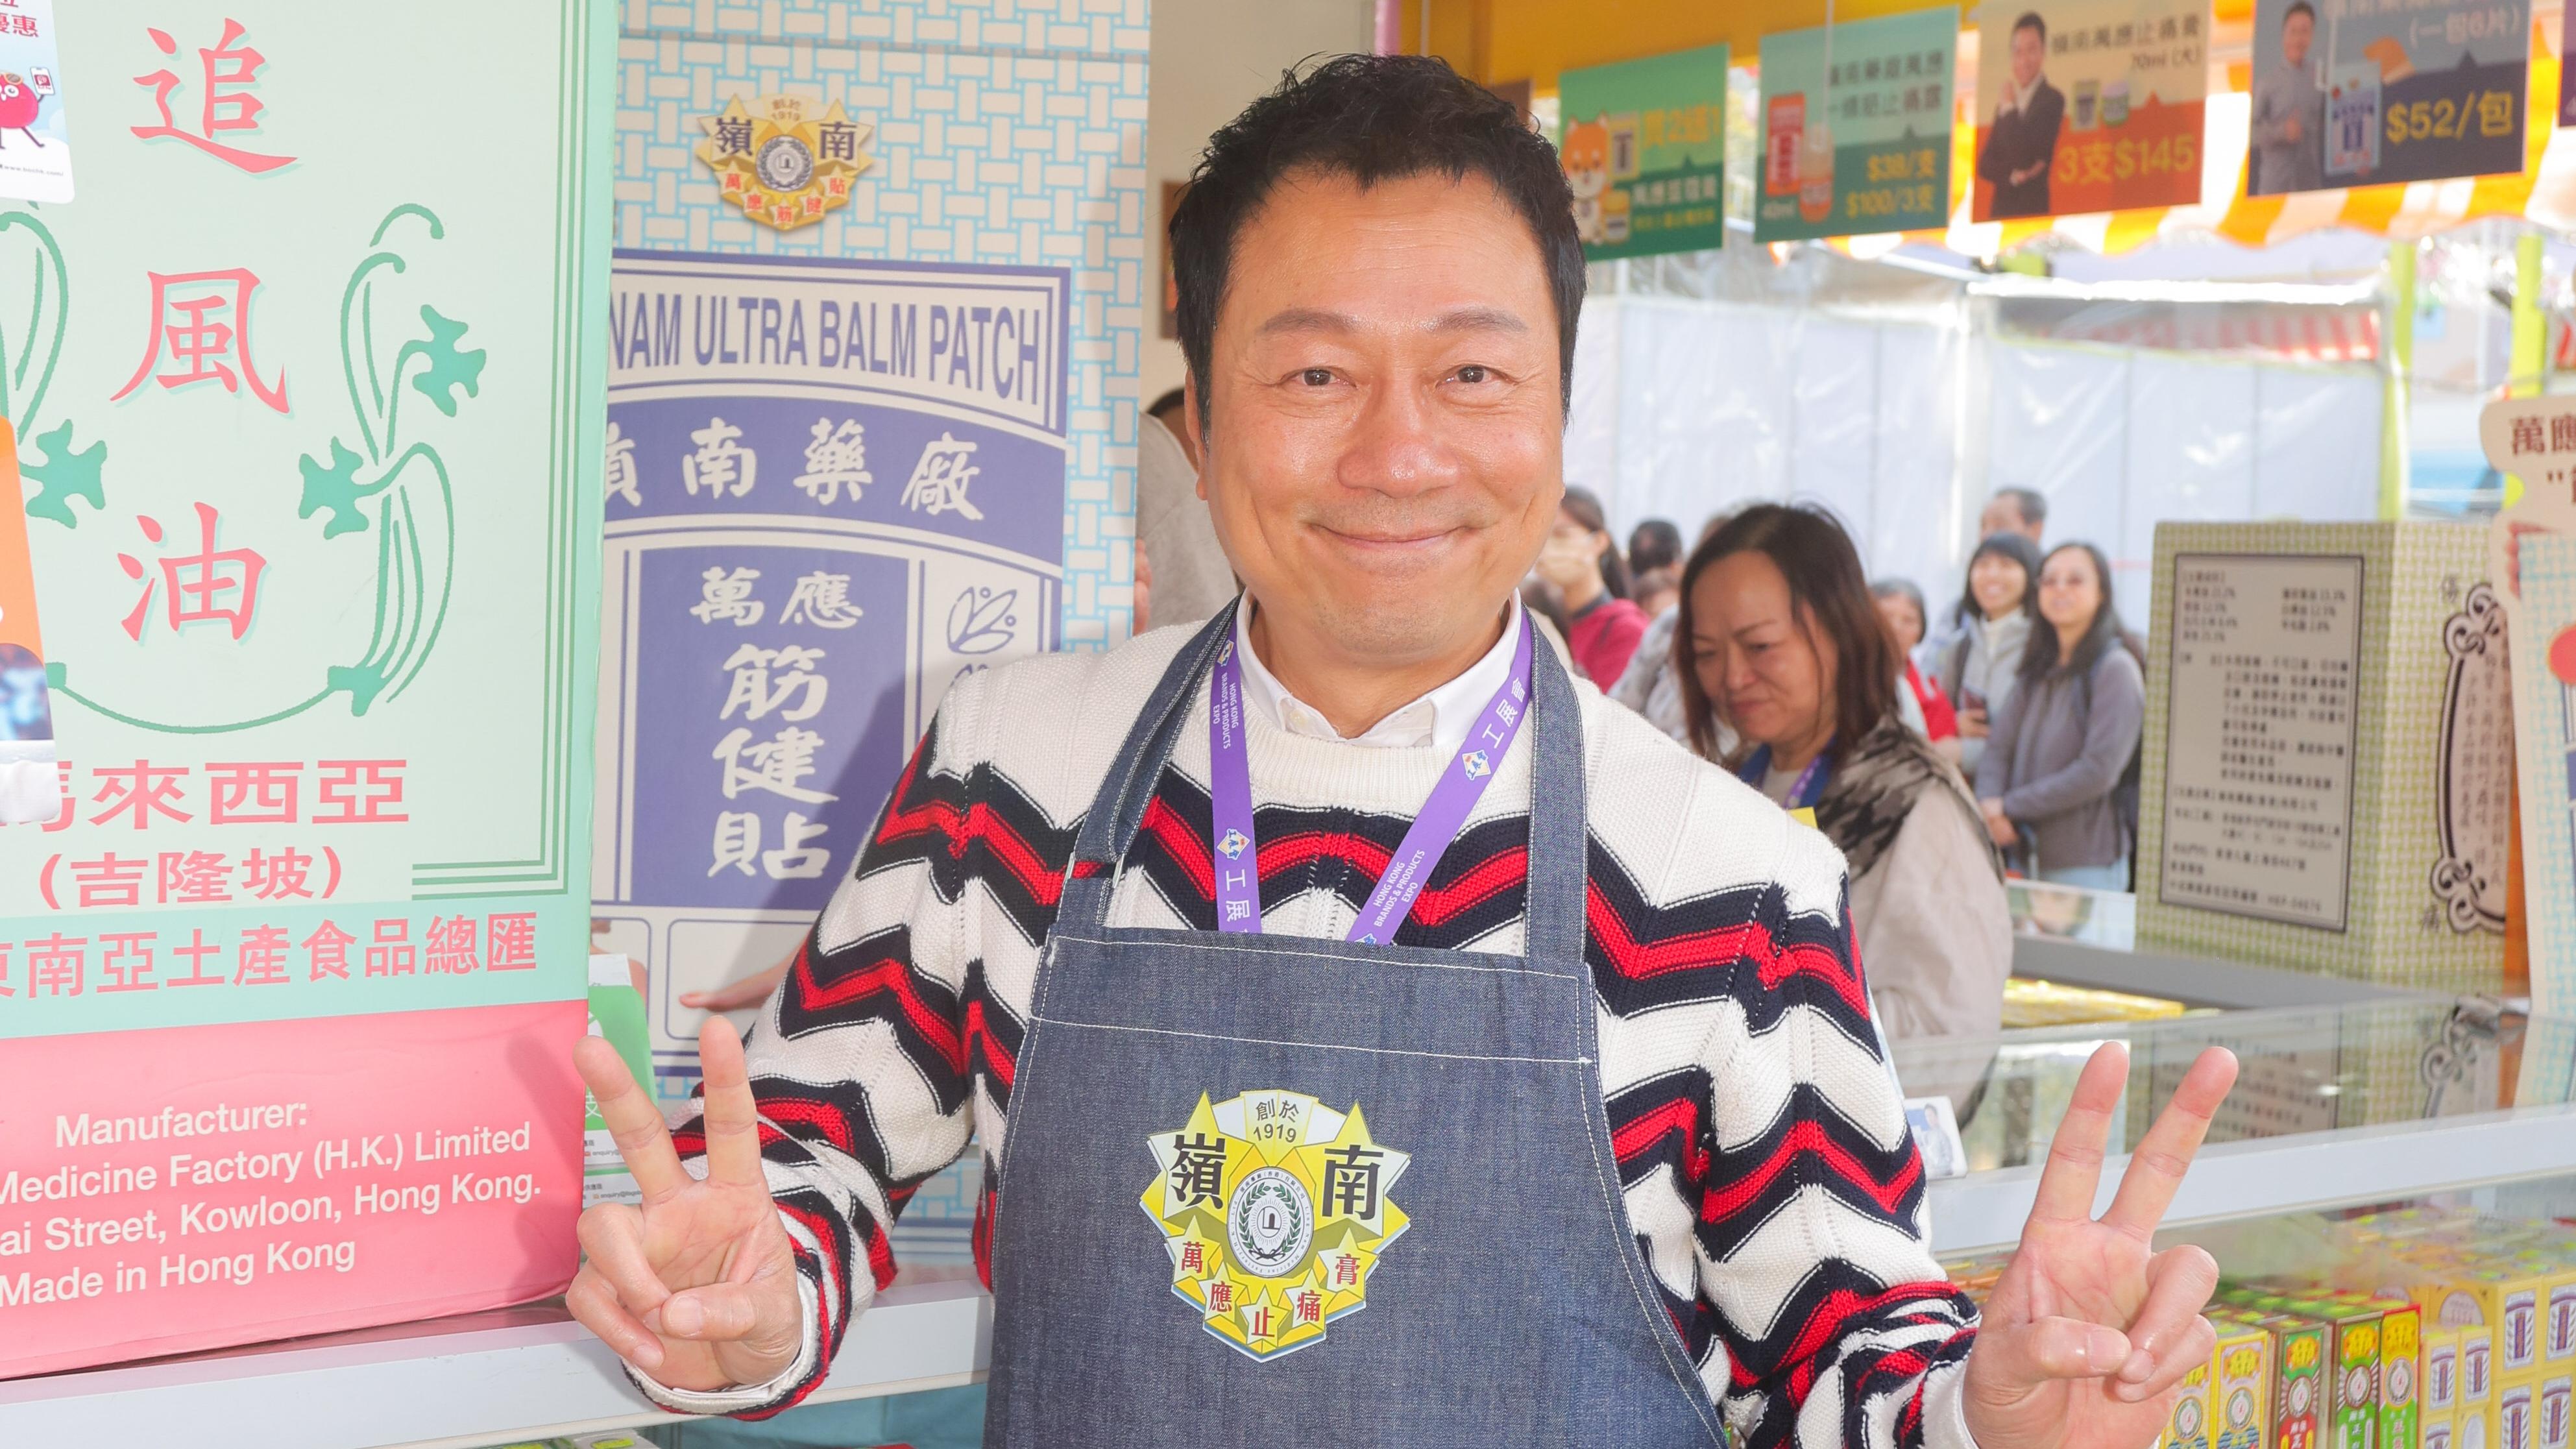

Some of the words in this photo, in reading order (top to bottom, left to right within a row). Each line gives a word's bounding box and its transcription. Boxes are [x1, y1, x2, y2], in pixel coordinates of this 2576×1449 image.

[2386, 89, 2513, 146] $52/包
[2058, 132, 2196, 186] 3支$145
[110, 18, 298, 641] 追風油
[694, 295, 807, 367] ULTRA
[819, 300, 917, 378] BALM
[929, 304, 1039, 406] PATCH
[690, 566, 864, 629] 萬應
[1229, 683, 1238, 707] HONG
[1230, 709, 1239, 729] KONG
[1481, 677, 1525, 749] 工展會
[1222, 709, 1232, 749] PRODUCTS
[708, 643, 839, 880] 筋健貼
[39, 846, 342, 908] (吉隆坡)
[1226, 869, 1250, 933] 工展
[1373, 884, 1392, 907] HONG
[1387, 861, 1405, 884] KONG
[1374, 895, 1398, 927] BRANDS
[1396, 849, 1426, 890] PRODUCTS
[1402, 882, 1418, 903] EXPO
[0, 911, 538, 999] 南亞土產食品總匯
[56, 1100, 308, 1148] Manufacturer:
[1253, 1123, 1296, 1143] 1919
[1256, 1099, 1299, 1124] 創於
[170, 1147, 304, 1187] Factory
[314, 1134, 404, 1180] (H.K.)
[416, 1121, 529, 1162] Limited
[45, 1212, 166, 1252] Street,
[181, 1197, 341, 1236] Kowloon,
[355, 1182, 440, 1216] Hong
[452, 1170, 541, 1204] Kong.
[0, 1267, 104, 1307] Made
[115, 1261, 147, 1293] in
[161, 1253, 254, 1287] Hong
[267, 1239, 356, 1274] Kong
[1180, 1240, 1360, 1338] 萬應止痛膏
